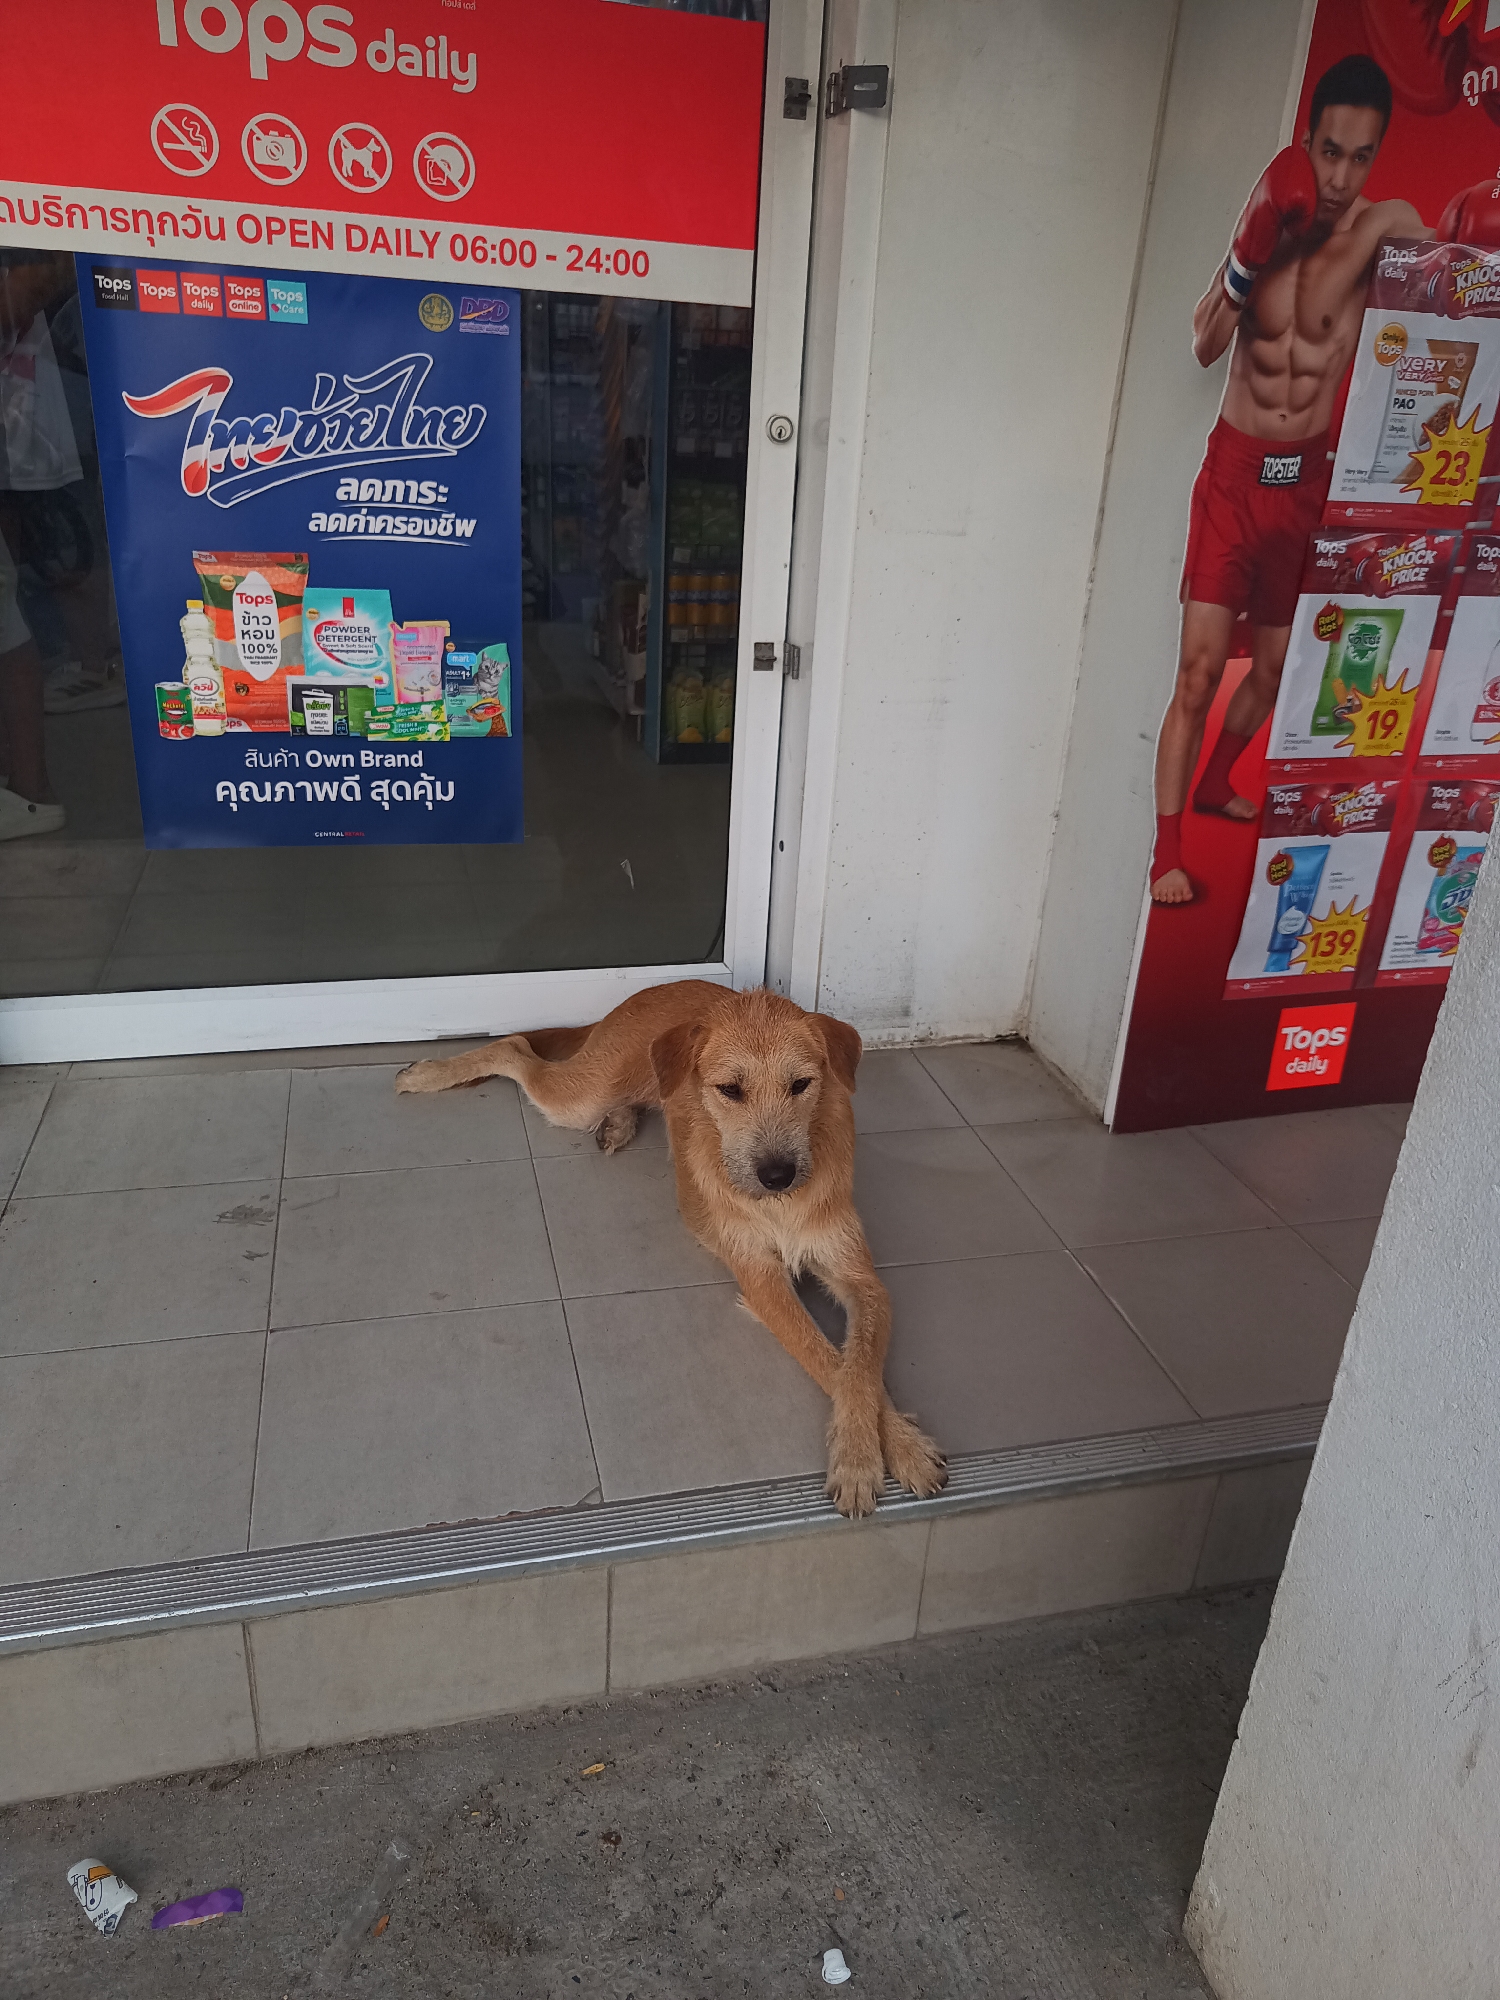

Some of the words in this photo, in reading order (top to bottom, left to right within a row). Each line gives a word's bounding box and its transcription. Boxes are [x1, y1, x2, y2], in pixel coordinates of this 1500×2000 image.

[366, 28, 477, 93] daily
[236, 214, 333, 250] OPEN
[345, 223, 440, 259] DAILY
[450, 233, 537, 268] 06:00
[546, 253, 557, 262] -
[566, 244, 649, 277] 24:00
[1382, 245, 1417, 266] Tops
[1450, 258, 1471, 270] Tops
[1384, 266, 1407, 282] daily
[1456, 264, 1500, 292] KNOC
[94, 275, 132, 292] Tops
[140, 282, 176, 299] Tops
[183, 282, 219, 298] Tops
[228, 283, 261, 298] Tops
[271, 288, 304, 304] Tops
[191, 300, 214, 311] daily
[231, 301, 260, 312] online
[281, 304, 304, 315] Care
[459, 296, 510, 322] DBD
[1377, 341, 1403, 356] Tops
[1393, 397, 1416, 410] PAO
[1262, 456, 1302, 478] TOPSTER
[336, 477, 450, 504] ลดภาระ
[308, 509, 477, 539] ลดค่าครองชีพ
[1314, 539, 1348, 558] Tops
[1476, 543, 1500, 561] Top
[1316, 558, 1339, 570] daily
[1382, 549, 1438, 575] KNOCK
[1391, 567, 1430, 588] PRICE
[236, 592, 274, 607] Tops
[242, 611, 272, 626] ข้าว
[1319, 611, 1337, 626] Red
[241, 629, 275, 641] หอม
[324, 626, 370, 634] POWDER
[1319, 622, 1337, 637] Hot
[317, 634, 377, 643] DETERGENT
[241, 643, 278, 654] 100%
[244, 747, 300, 768] สินค้า
[305, 750, 354, 768] Own
[360, 750, 424, 768] Brand
[215, 774, 362, 812] คุณภาพดี
[370, 772, 455, 811] สุดคุ้ม
[1271, 790, 1302, 806] Tops
[1431, 786, 1461, 800] Tops
[1273, 806, 1294, 815] daily
[1334, 793, 1387, 815] KNOCK
[1342, 808, 1379, 828] PRICE
[1281, 1025, 1348, 1055] Tops
[1285, 1055, 1329, 1076] daily
